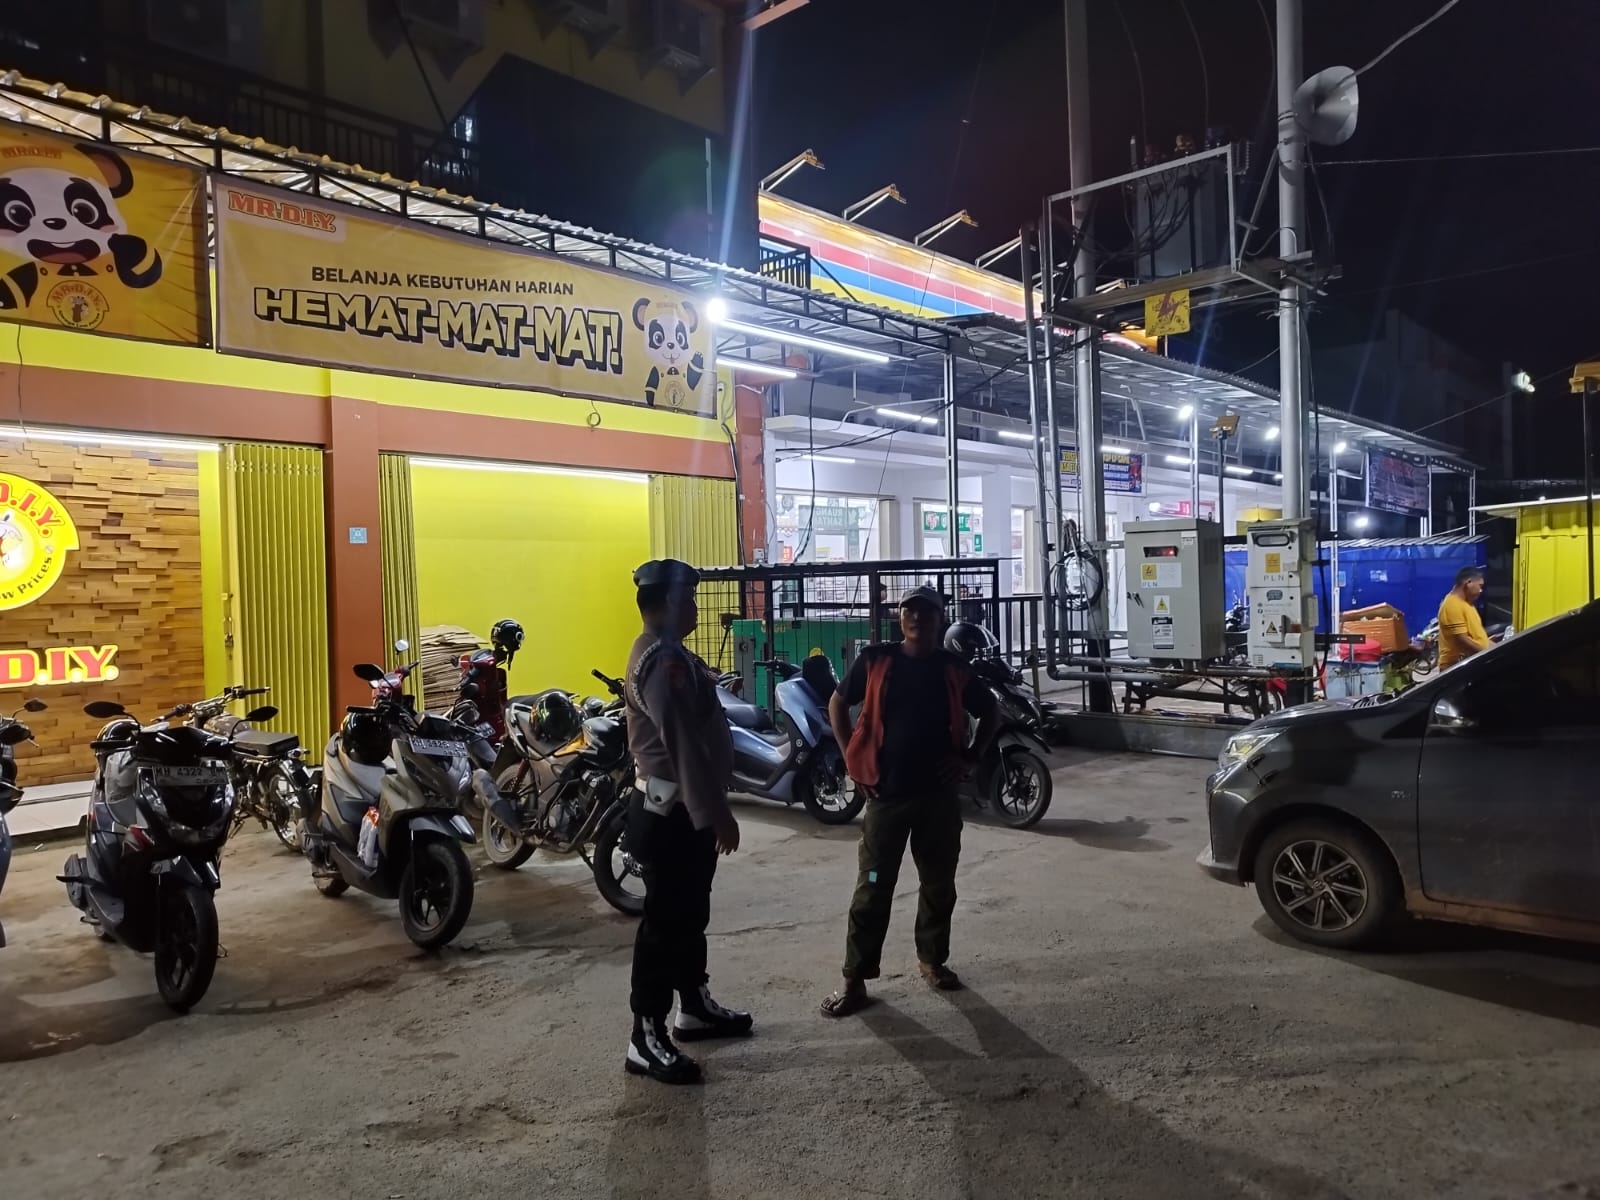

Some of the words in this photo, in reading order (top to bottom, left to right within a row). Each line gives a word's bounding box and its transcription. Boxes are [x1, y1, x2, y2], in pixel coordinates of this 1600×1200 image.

[311, 266, 402, 287] BELANJA
[406, 273, 511, 294] KEBUTUHAN
[515, 281, 574, 296] HARIAN
[253, 287, 623, 375] HEMAT-MAT-MAT!
[17, 556, 52, 594] Prices
